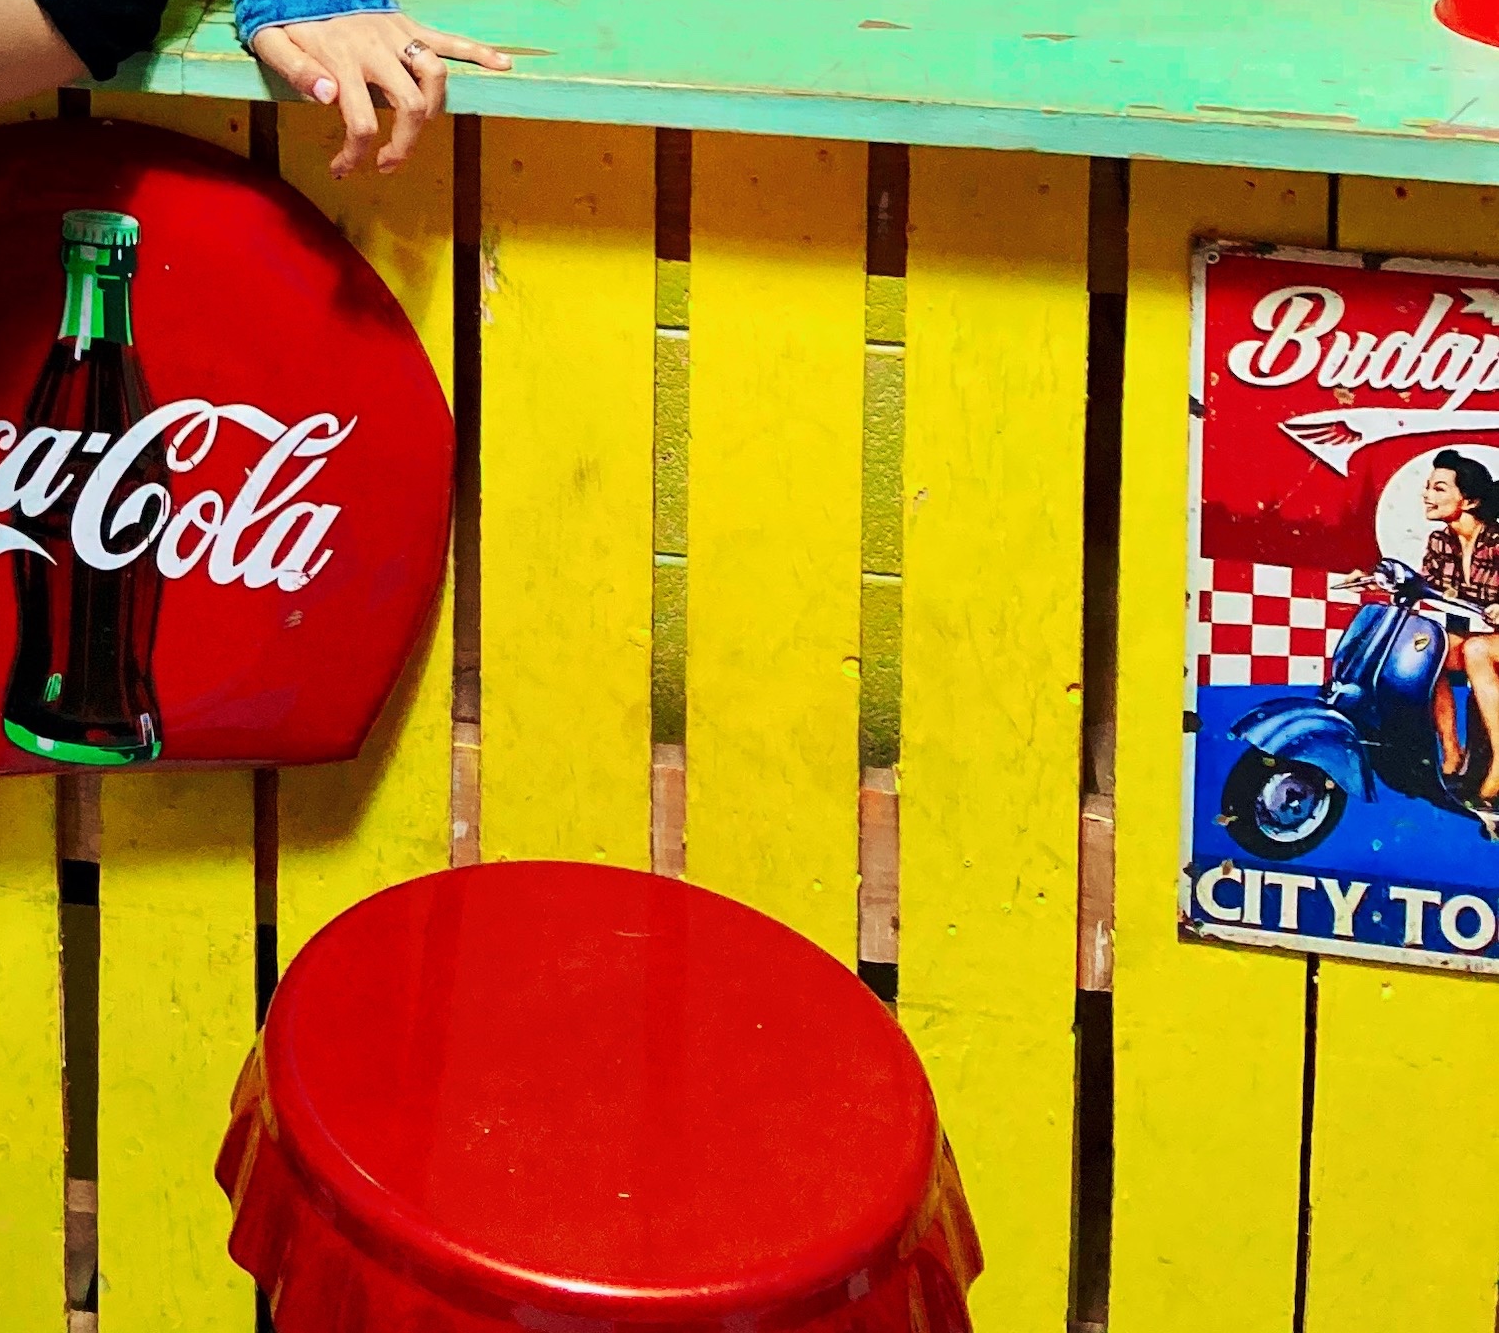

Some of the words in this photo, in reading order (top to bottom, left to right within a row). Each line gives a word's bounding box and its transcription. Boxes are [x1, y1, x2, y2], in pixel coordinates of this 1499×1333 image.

[1228, 285, 1499, 412] Budap
[1196, 866, 1371, 937] CITY
[1389, 885, 1499, 951] TO
